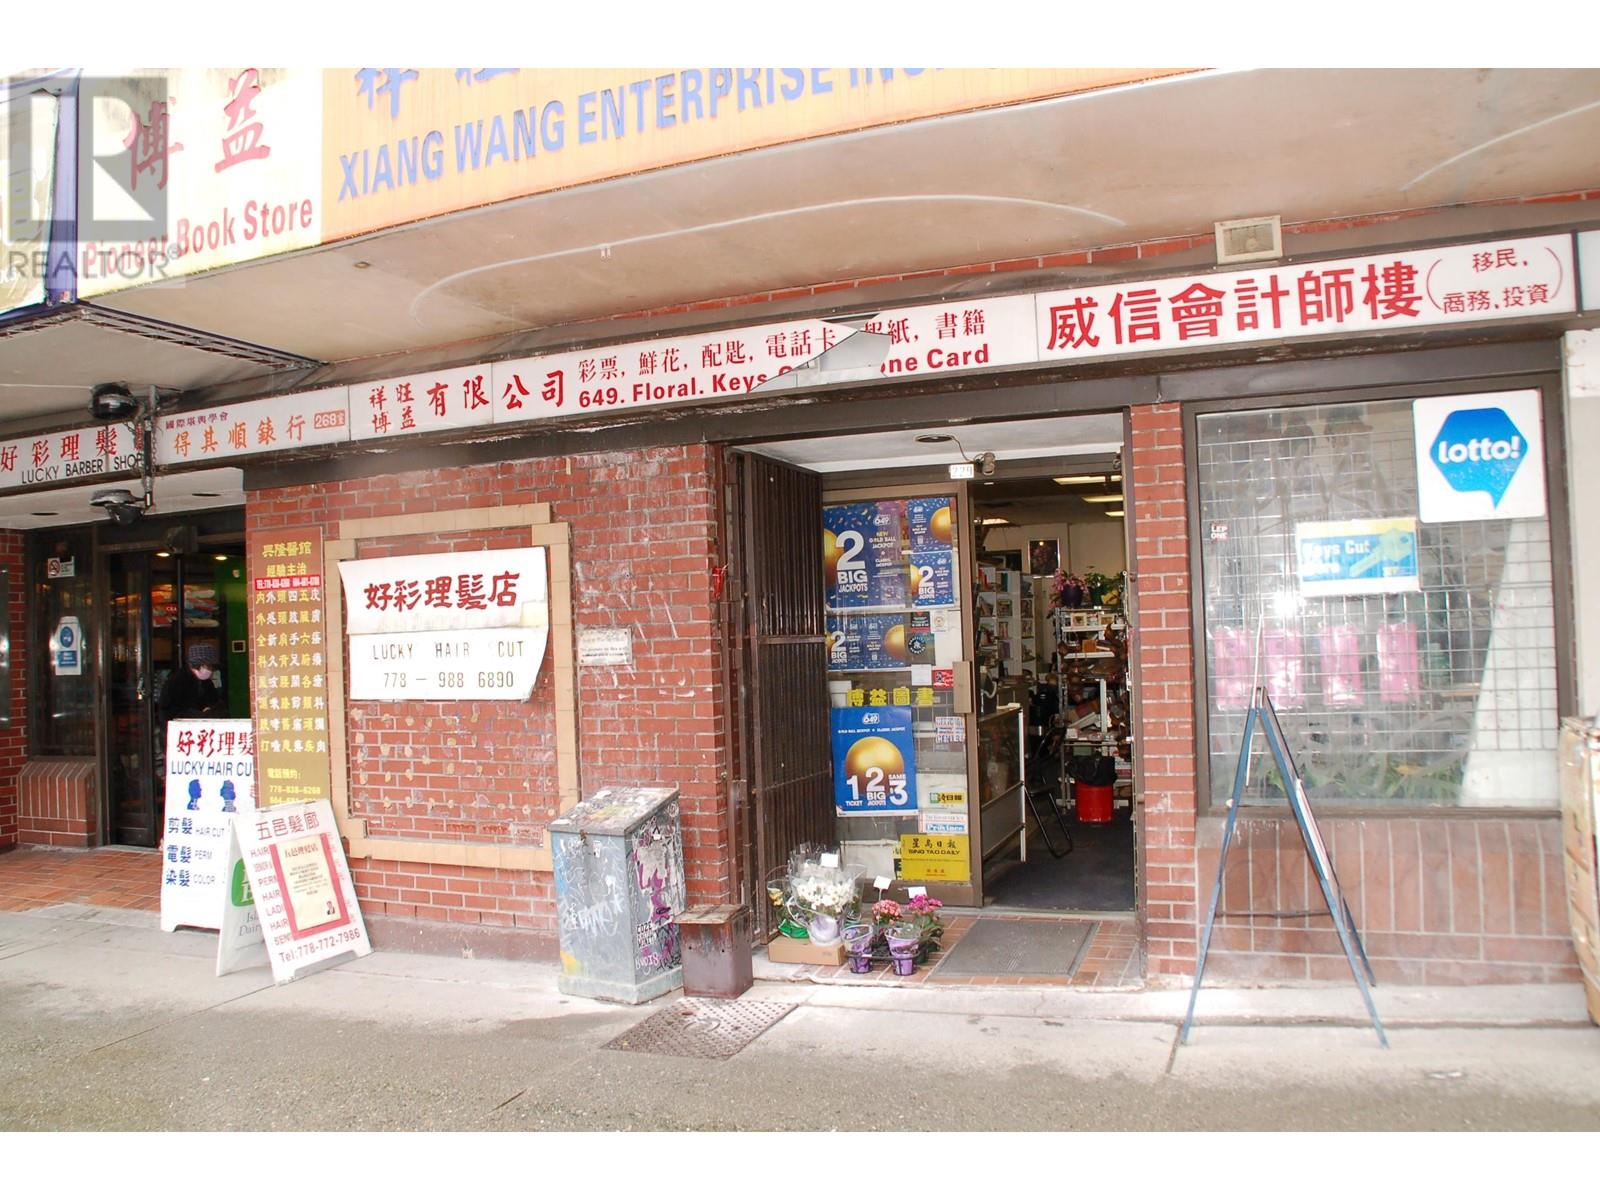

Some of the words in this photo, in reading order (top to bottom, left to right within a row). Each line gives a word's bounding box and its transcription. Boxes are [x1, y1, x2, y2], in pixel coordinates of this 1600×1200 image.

[339, 129, 444, 201] XIANG
[454, 99, 565, 174] WANG
[578, 68, 833, 146] ENTERPRISE
[177, 207, 235, 257] Book
[243, 198, 313, 241] Store
[1046, 261, 1423, 350] 威信會計師樓
[935, 309, 986, 340] 書籍
[927, 343, 989, 370] Card
[426, 370, 564, 417] 有限公司
[372, 406, 417, 433] 博益
[1438, 435, 1521, 464] lotto!
[21, 465, 59, 484] LUCKY
[66, 458, 103, 477] BARBER
[114, 452, 143, 470] SHOP
[835, 530, 866, 571] 2
[1345, 539, 1371, 555] Cut
[837, 570, 868, 585] BIG
[838, 583, 869, 593] JACKPOTS
[918, 565, 934, 587] 2
[363, 571, 521, 611] 好彩理髮店
[918, 587, 935, 595] BIG
[372, 643, 413, 660] LUCKY
[435, 641, 470, 658] HAIR
[497, 640, 525, 658] CUT
[831, 630, 846, 652] 2
[831, 651, 847, 660] BIG
[384, 672, 407, 688] 778
[438, 671, 465, 688] 988
[478, 671, 514, 688] 6890
[171, 760, 204, 775] LUCKY
[207, 761, 233, 776] HAIR
[237, 762, 252, 776] CU
[865, 766, 885, 791] 2
[846, 775, 859, 800] 1
[867, 791, 886, 801] BIG
[256, 811, 320, 840] 五邑髮廊
[167, 844, 192, 863] 電髮
